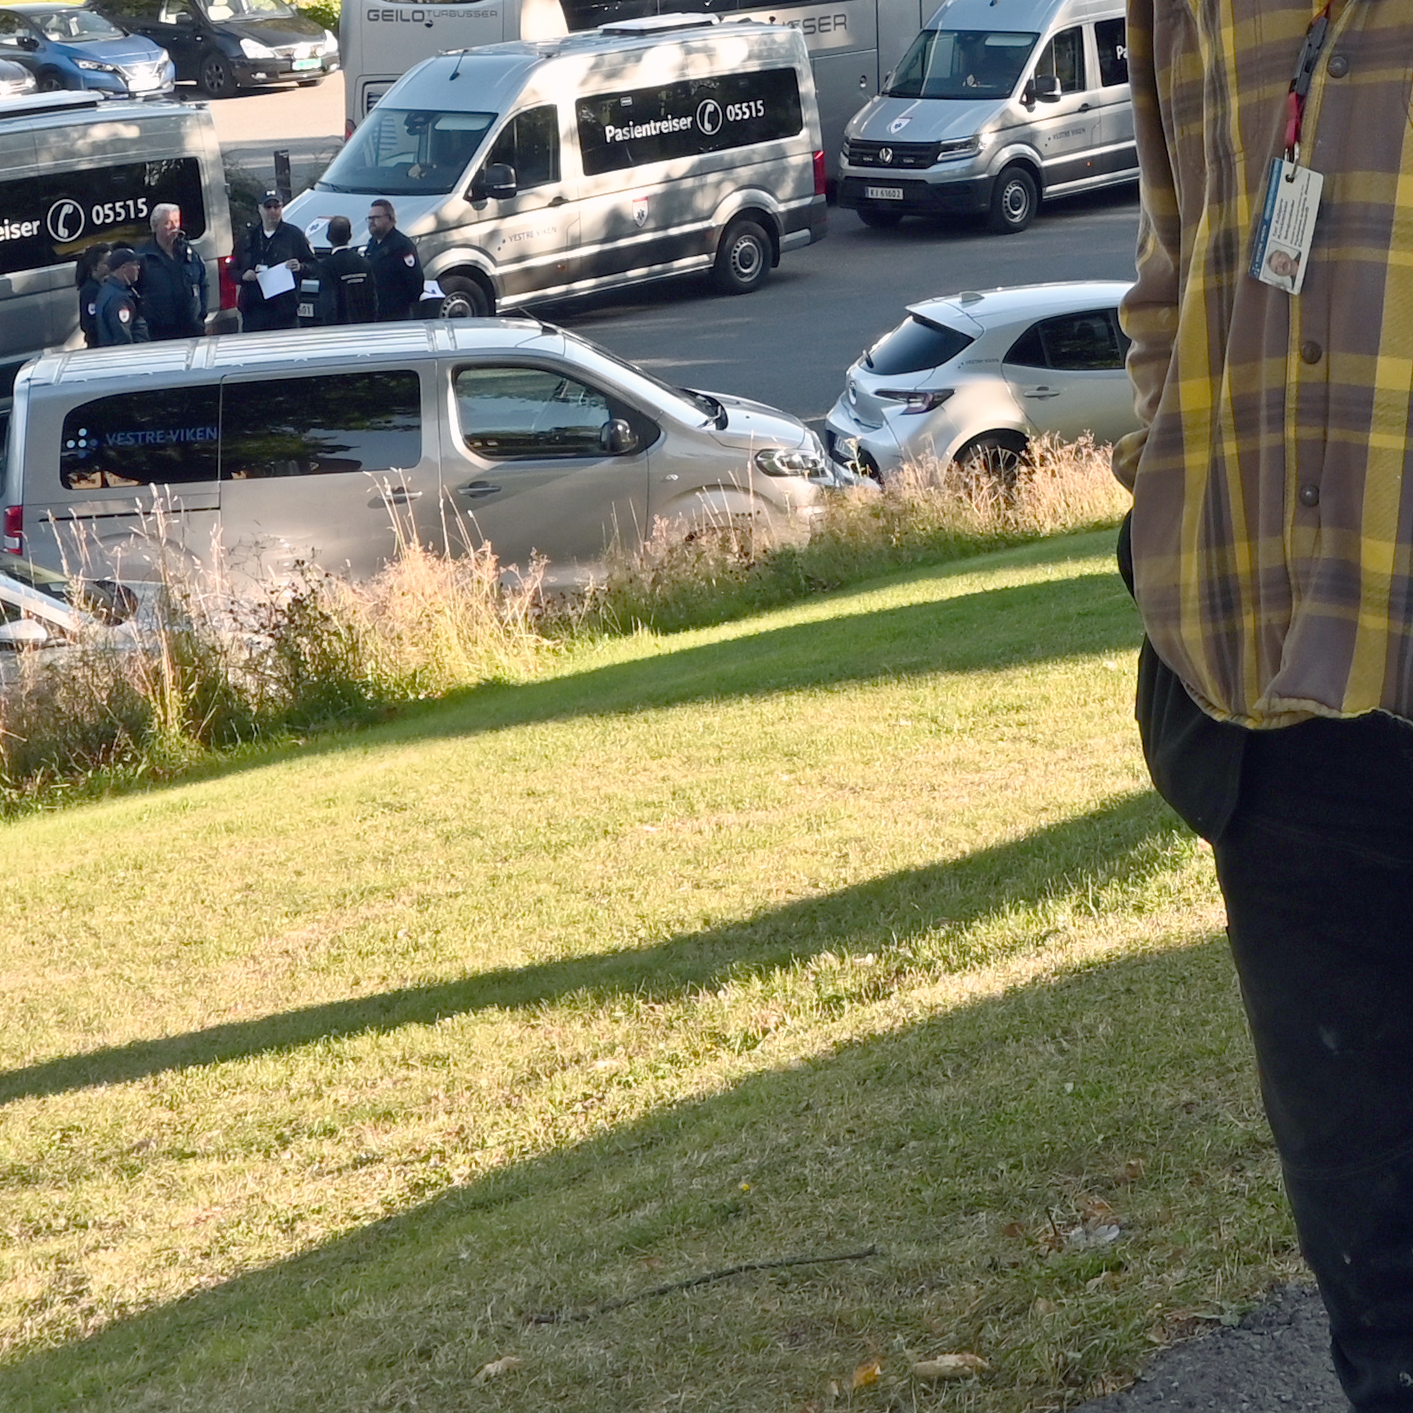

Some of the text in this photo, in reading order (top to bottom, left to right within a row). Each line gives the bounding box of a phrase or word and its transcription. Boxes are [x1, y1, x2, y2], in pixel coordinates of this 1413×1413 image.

[367, 9, 425, 23] GEILO
[605, 99, 765, 143] Pasientreiser 05515
[92, 197, 148, 225] 05515
[105, 427, 218, 446] VESTRE VIKEN
